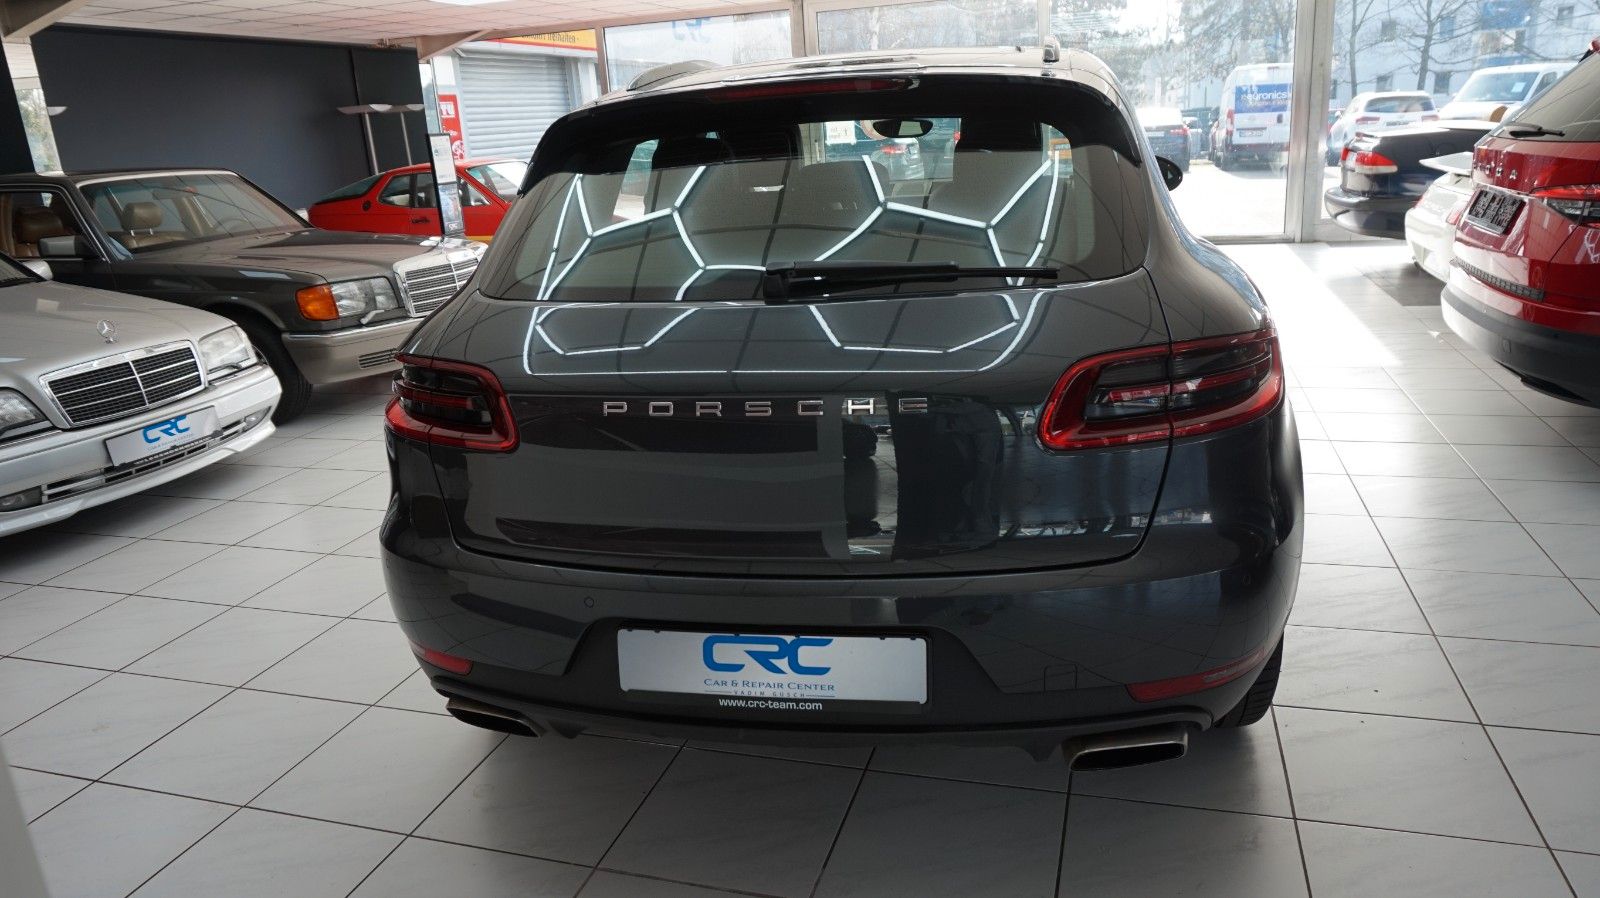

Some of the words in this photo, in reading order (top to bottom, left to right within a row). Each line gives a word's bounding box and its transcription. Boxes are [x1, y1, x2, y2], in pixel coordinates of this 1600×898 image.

[603, 397, 928, 417] PORSCHE
[143, 414, 191, 443] CRC
[703, 635, 834, 676] CRC
[704, 679, 728, 687] CAR
[742, 680, 784, 690] REPAIR
[787, 682, 835, 691] CENTER
[719, 699, 823, 710] www.crc-team.com
